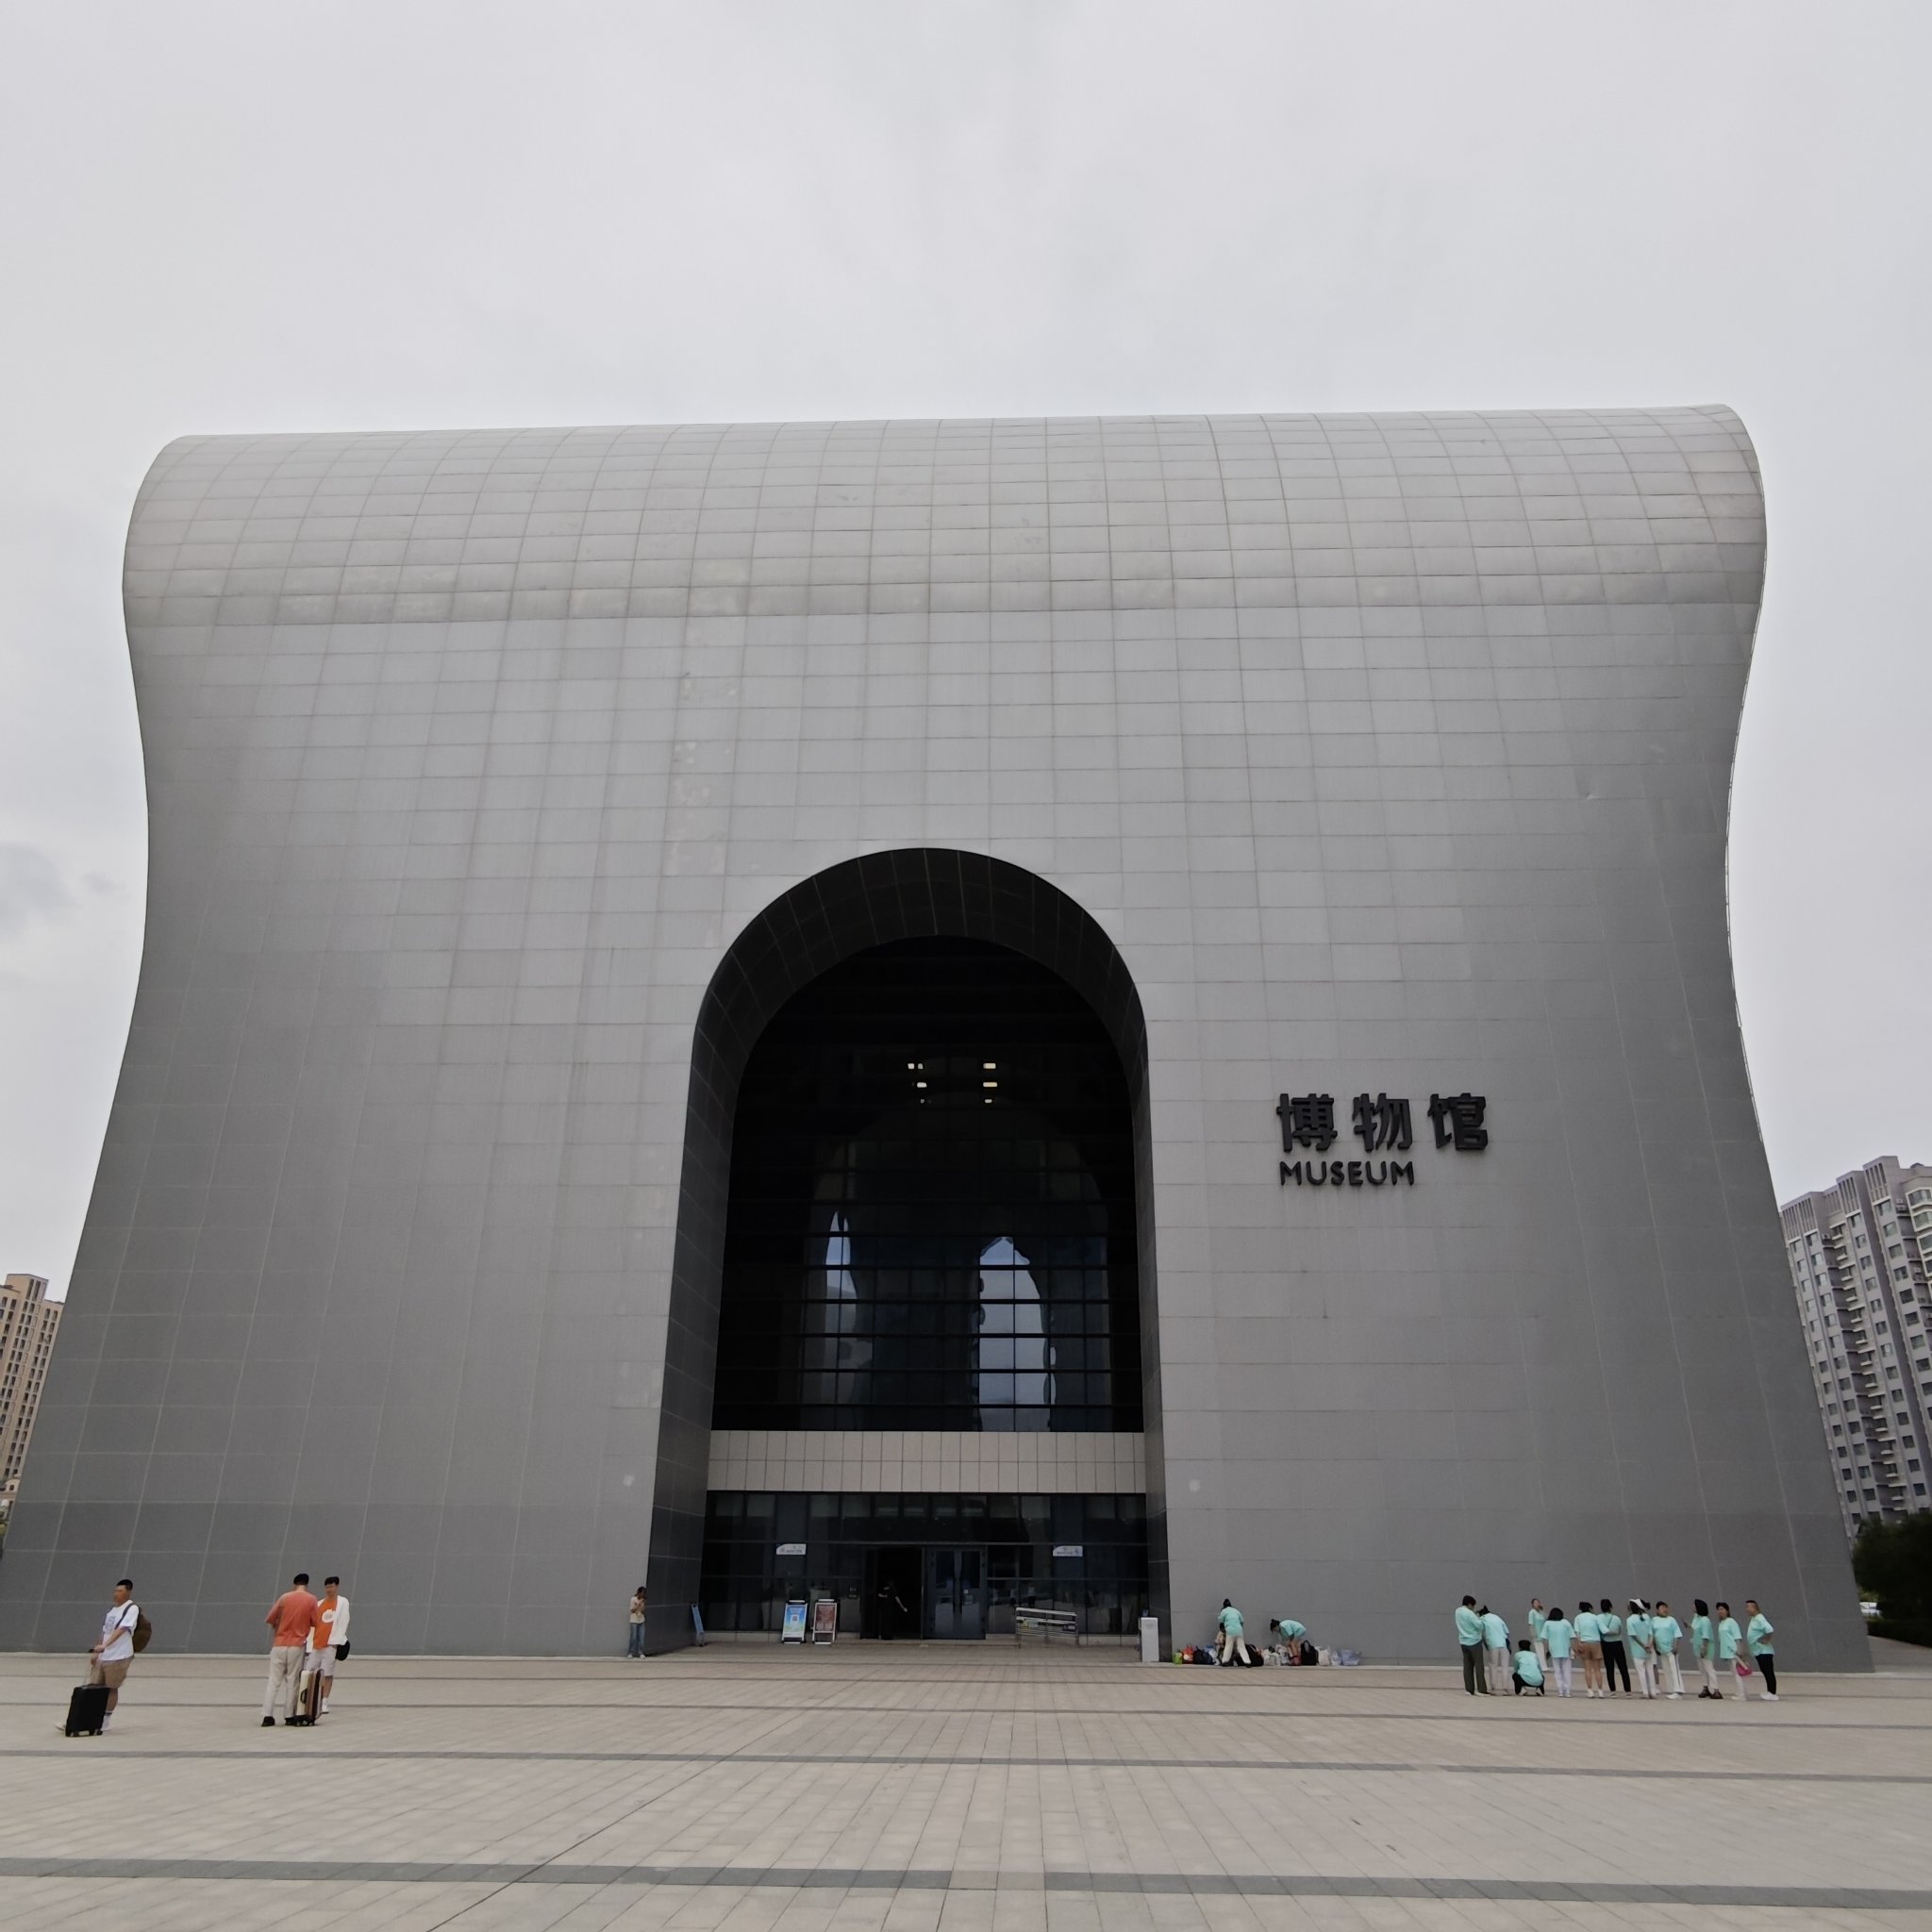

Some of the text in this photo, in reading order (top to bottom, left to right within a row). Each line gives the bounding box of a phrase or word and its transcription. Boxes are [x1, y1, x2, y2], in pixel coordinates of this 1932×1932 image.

[1276, 1092, 1489, 1153] 博物馆
[1279, 1160, 1415, 1186] MUSEUM
